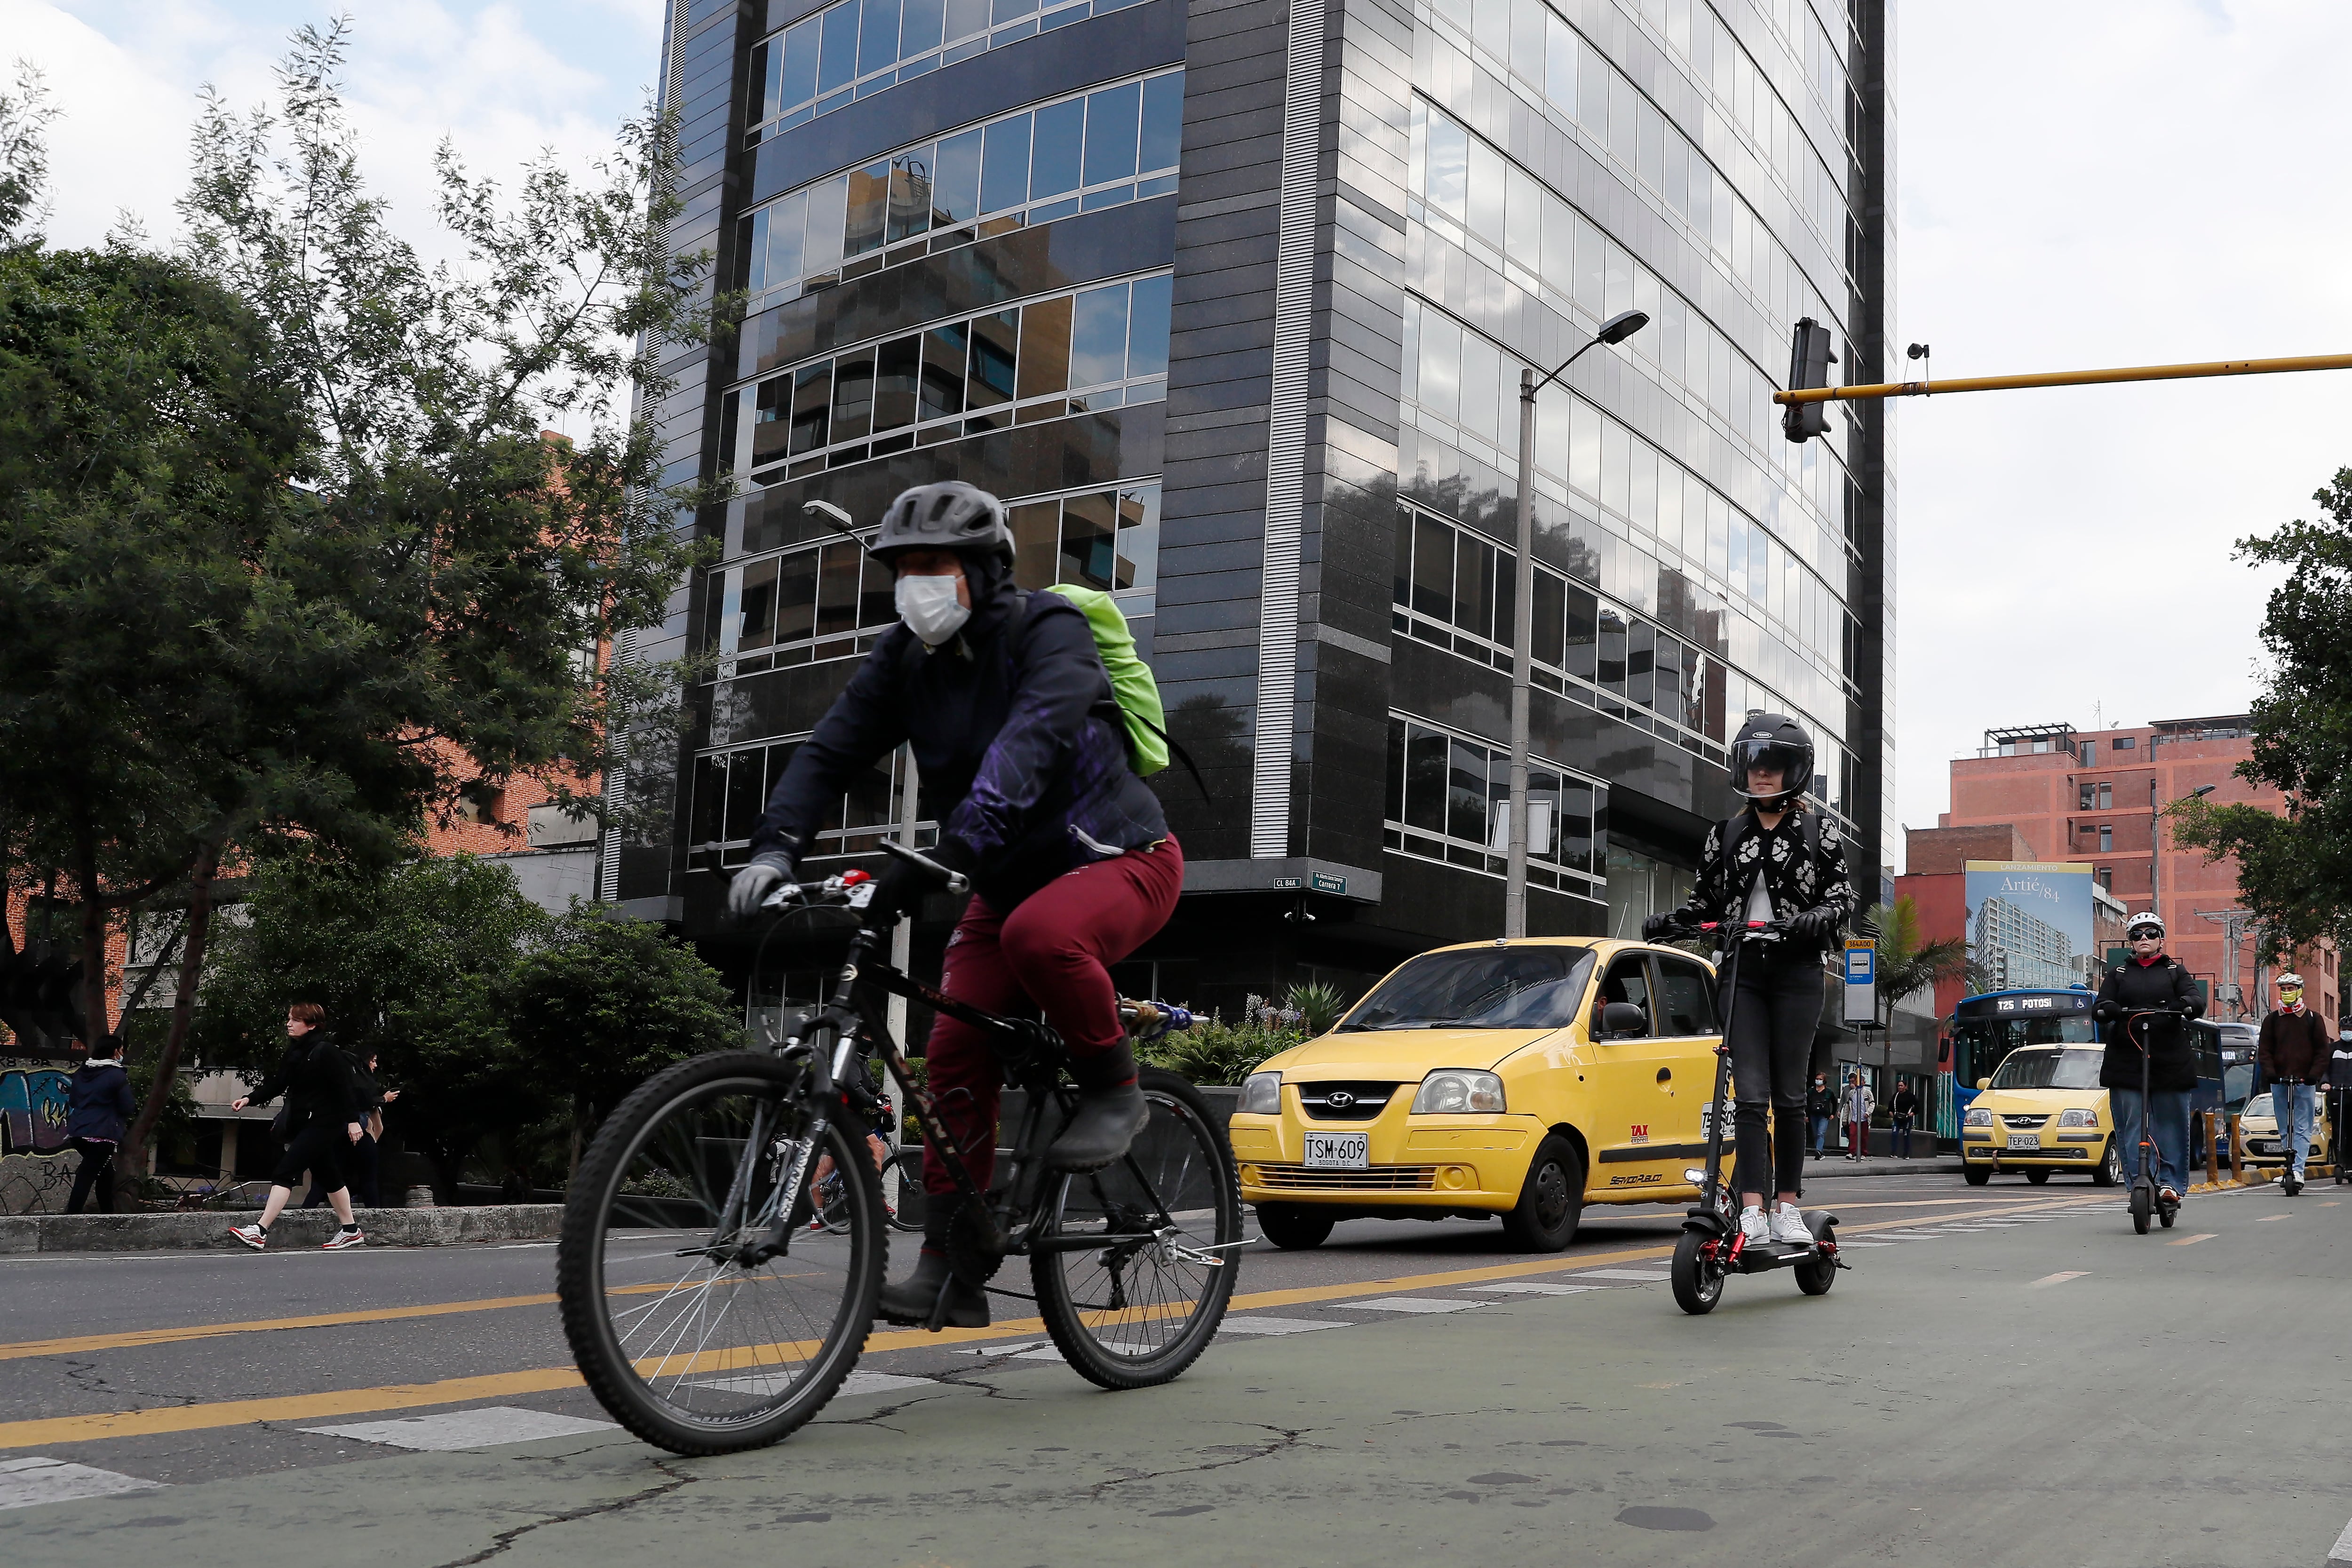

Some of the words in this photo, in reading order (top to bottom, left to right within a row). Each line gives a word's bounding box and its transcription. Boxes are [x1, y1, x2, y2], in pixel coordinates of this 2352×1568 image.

[1319, 880, 1336, 890] Carrera
[1998, 1000, 2014, 1010] T25
[1631, 1124, 1648, 1137] TAX
